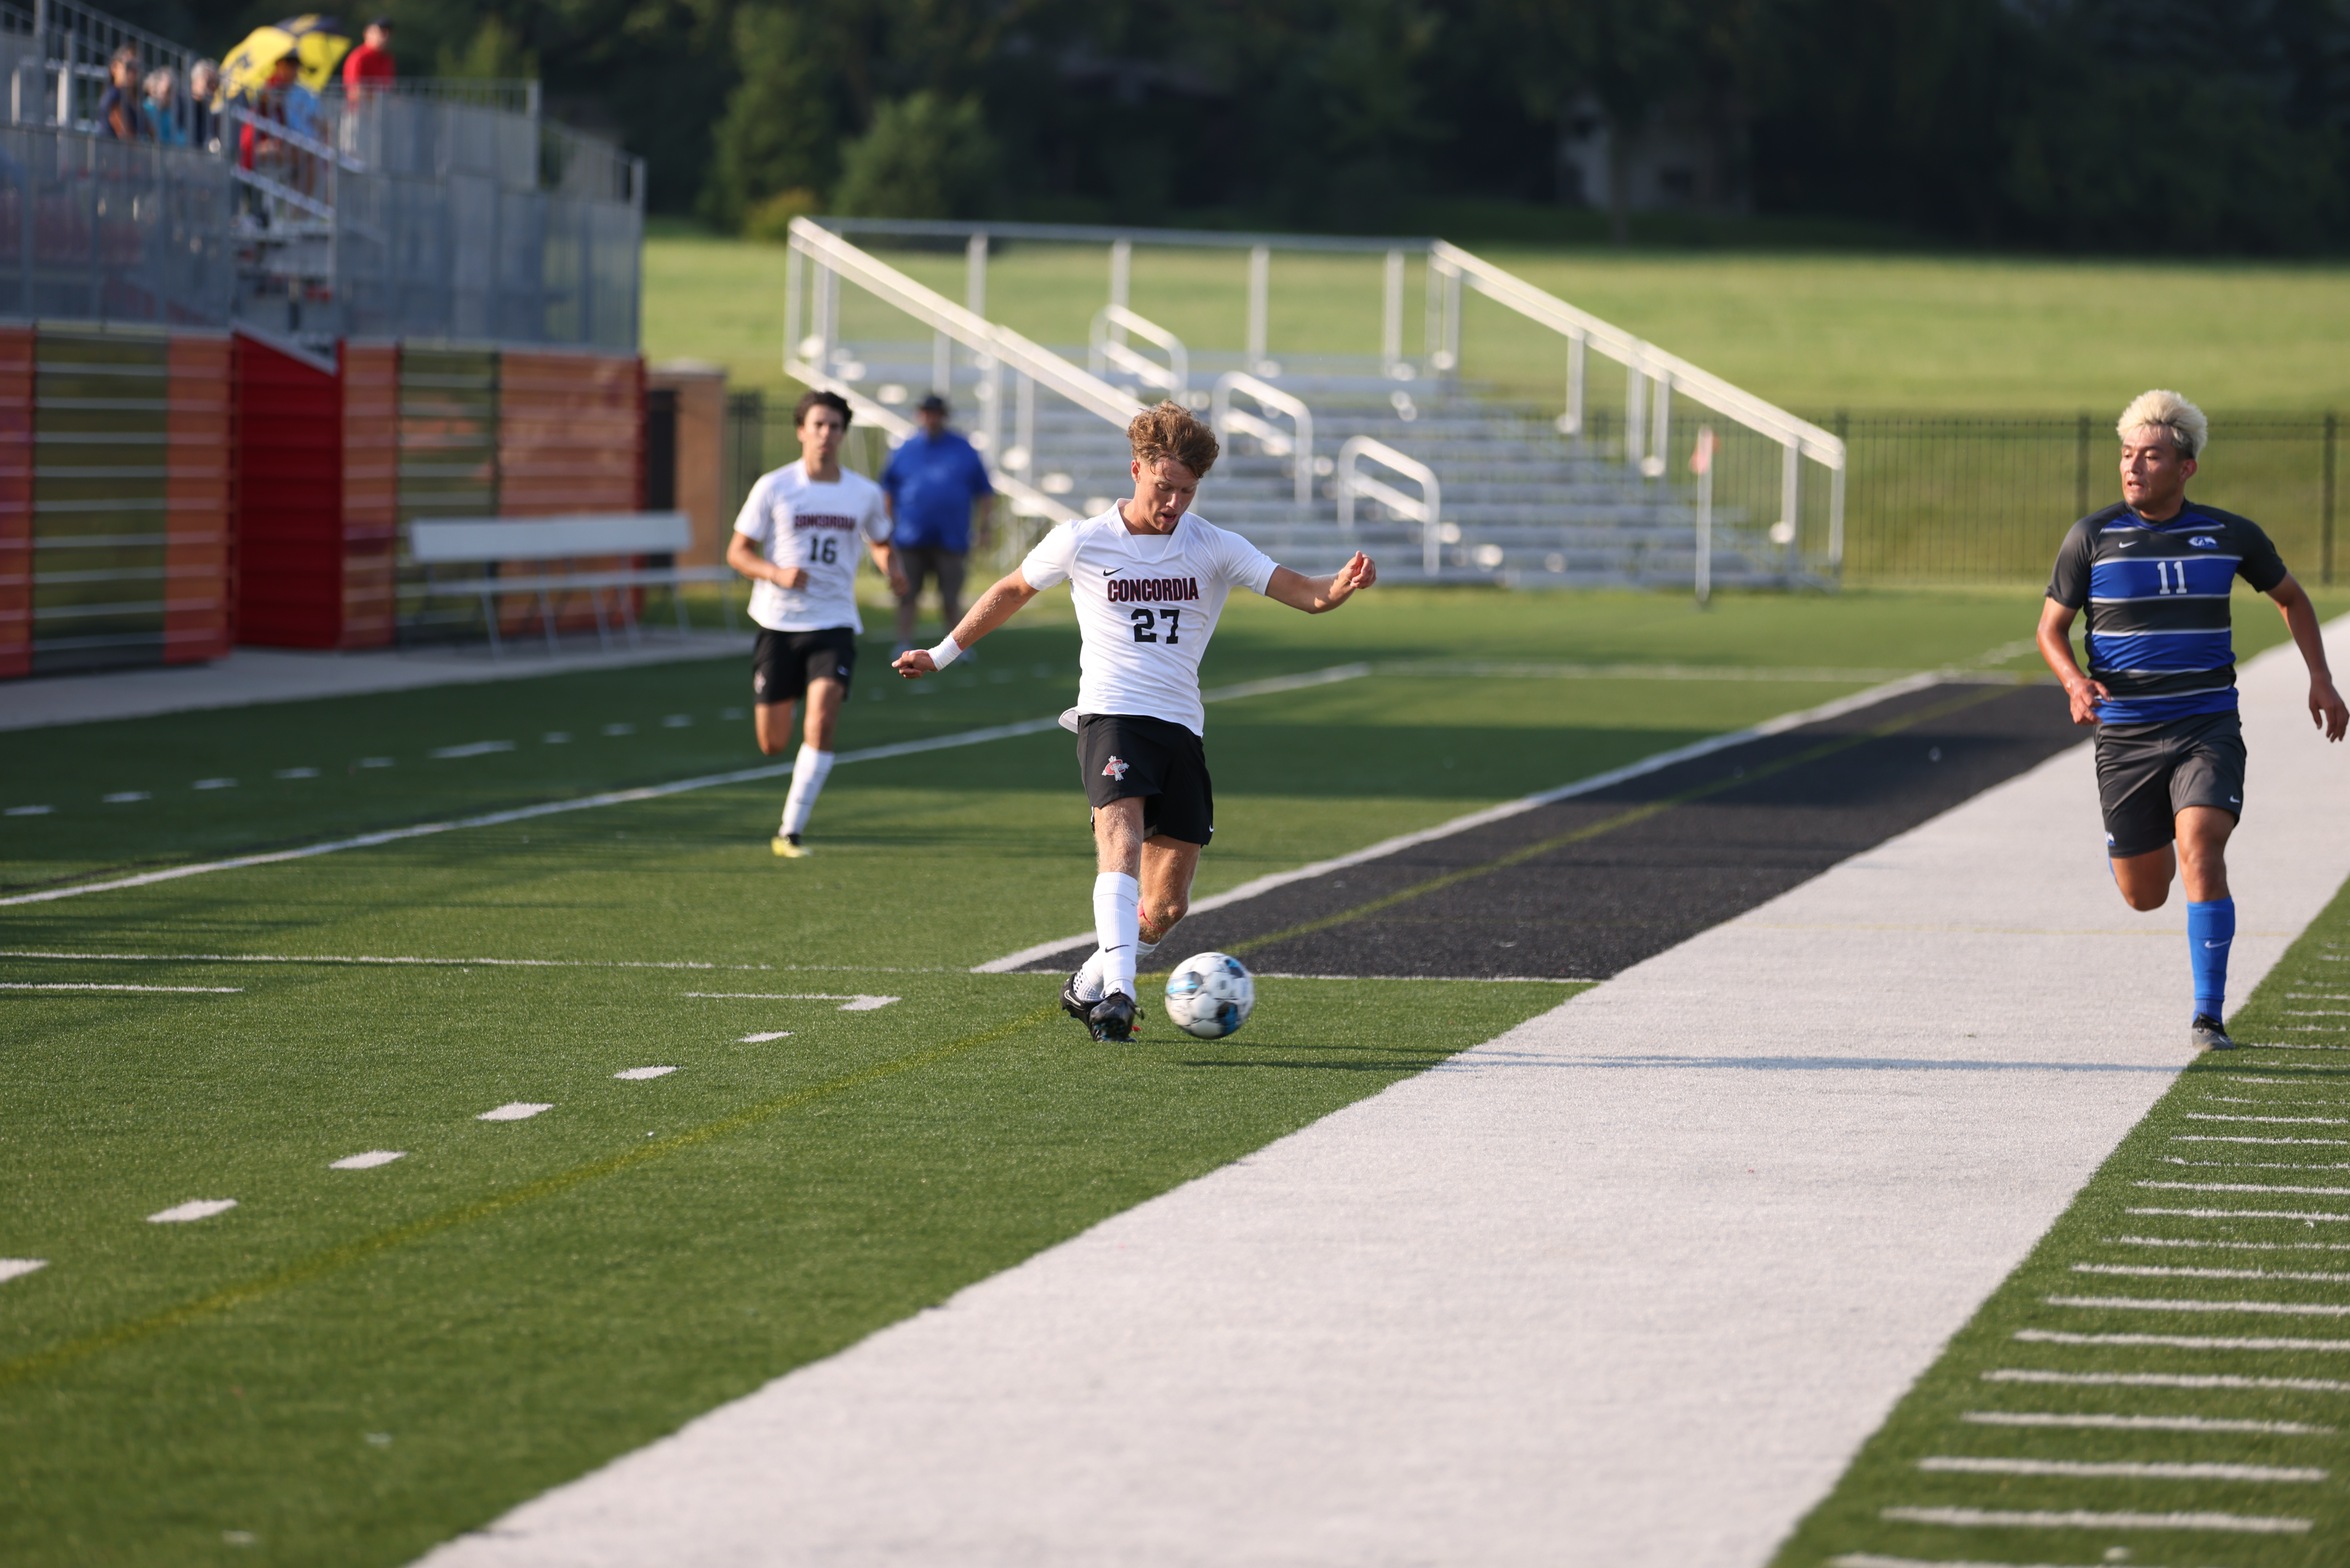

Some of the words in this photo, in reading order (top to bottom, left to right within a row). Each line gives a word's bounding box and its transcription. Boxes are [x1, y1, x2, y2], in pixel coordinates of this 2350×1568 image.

[810, 536, 838, 564] 16
[1107, 577, 1200, 602] CONCORDIA
[2157, 560, 2188, 595] 11
[1130, 608, 1180, 644] 27
